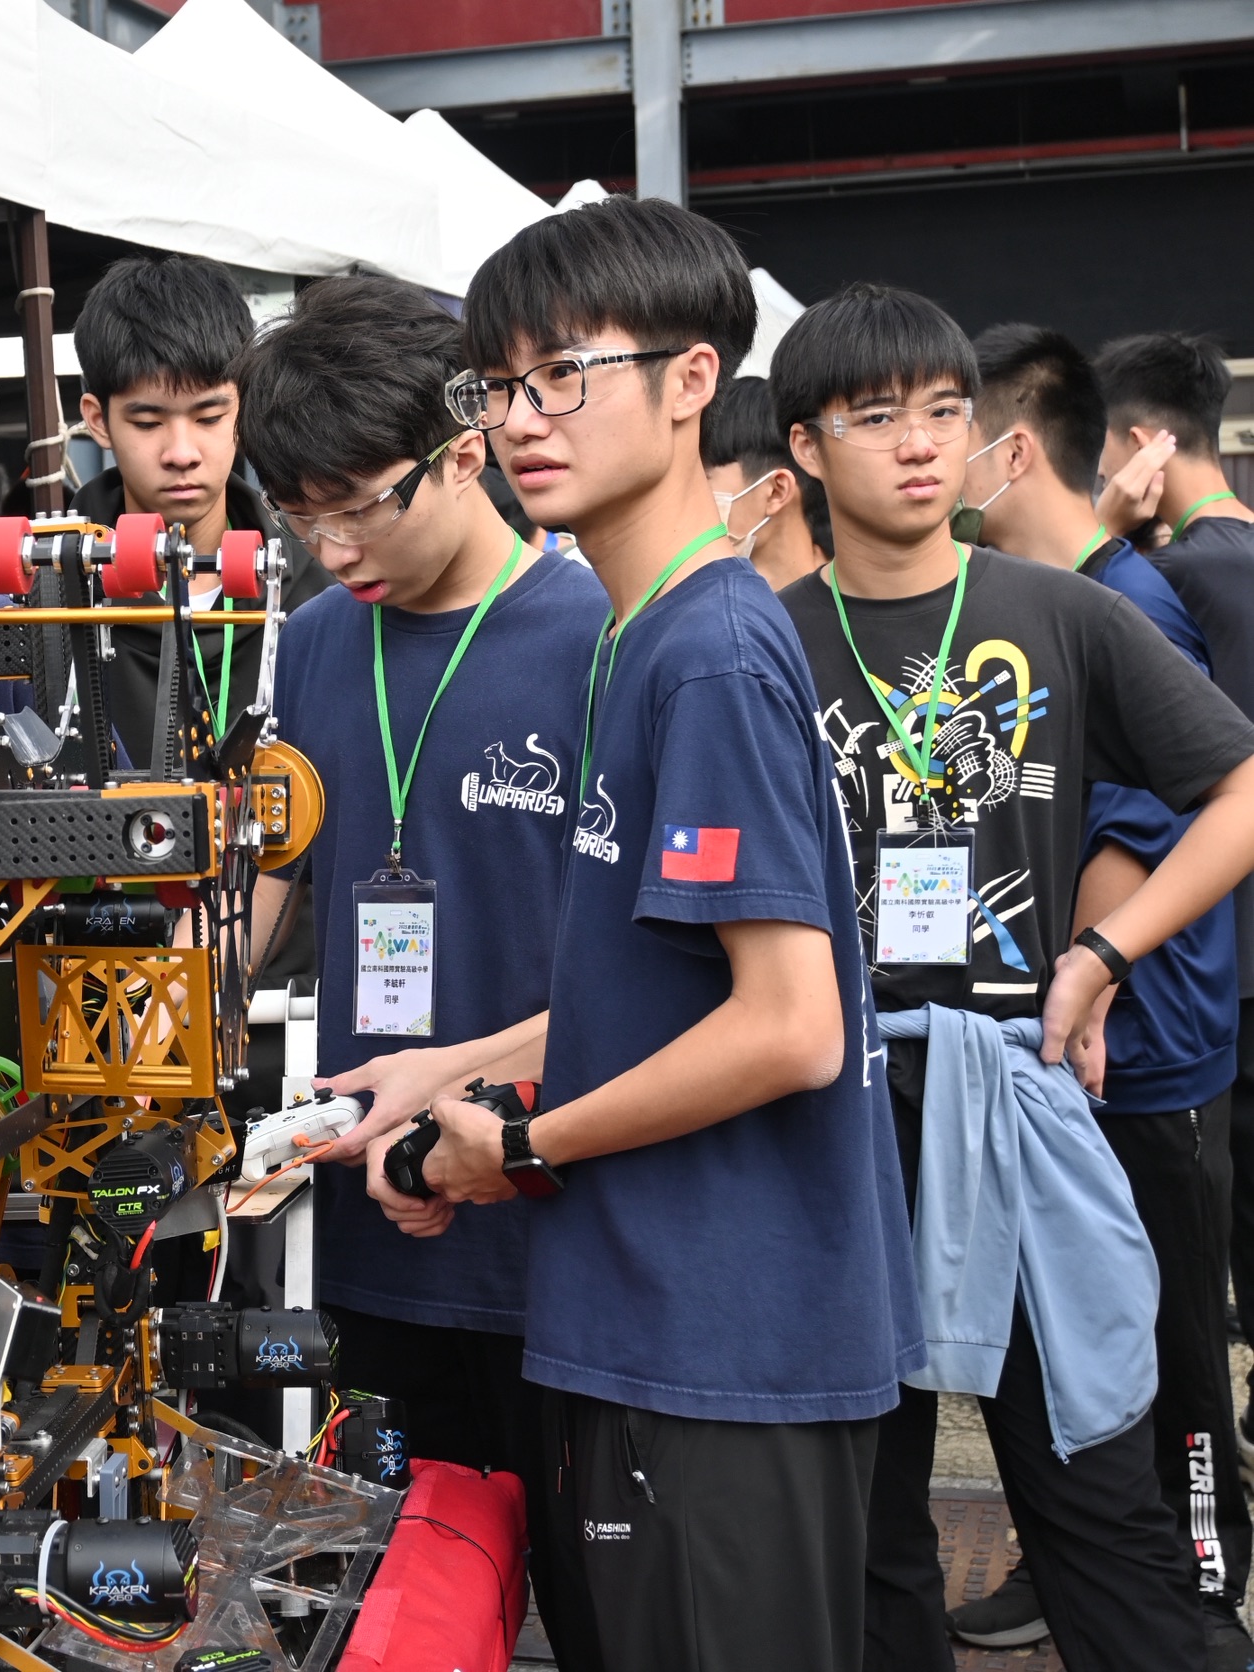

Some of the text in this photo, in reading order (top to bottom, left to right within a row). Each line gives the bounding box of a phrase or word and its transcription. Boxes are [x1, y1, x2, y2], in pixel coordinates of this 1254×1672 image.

[477, 784, 558, 815] UNIPARDS
[86, 916, 136, 925] KRAEN
[912, 925, 929, 933] 同學
[383, 994, 400, 1005] 同學
[213, 1164, 236, 1176] GHT
[92, 1186, 135, 1198] TALON
[137, 1184, 161, 1195] FX
[117, 1202, 143, 1211] CTR
[255, 1354, 303, 1363] KRAKEN
[269, 1361, 290, 1369] X60
[596, 1523, 631, 1532] FASHION
[89, 1584, 150, 1596] KRAKEN
[107, 1594, 134, 1602] X60
